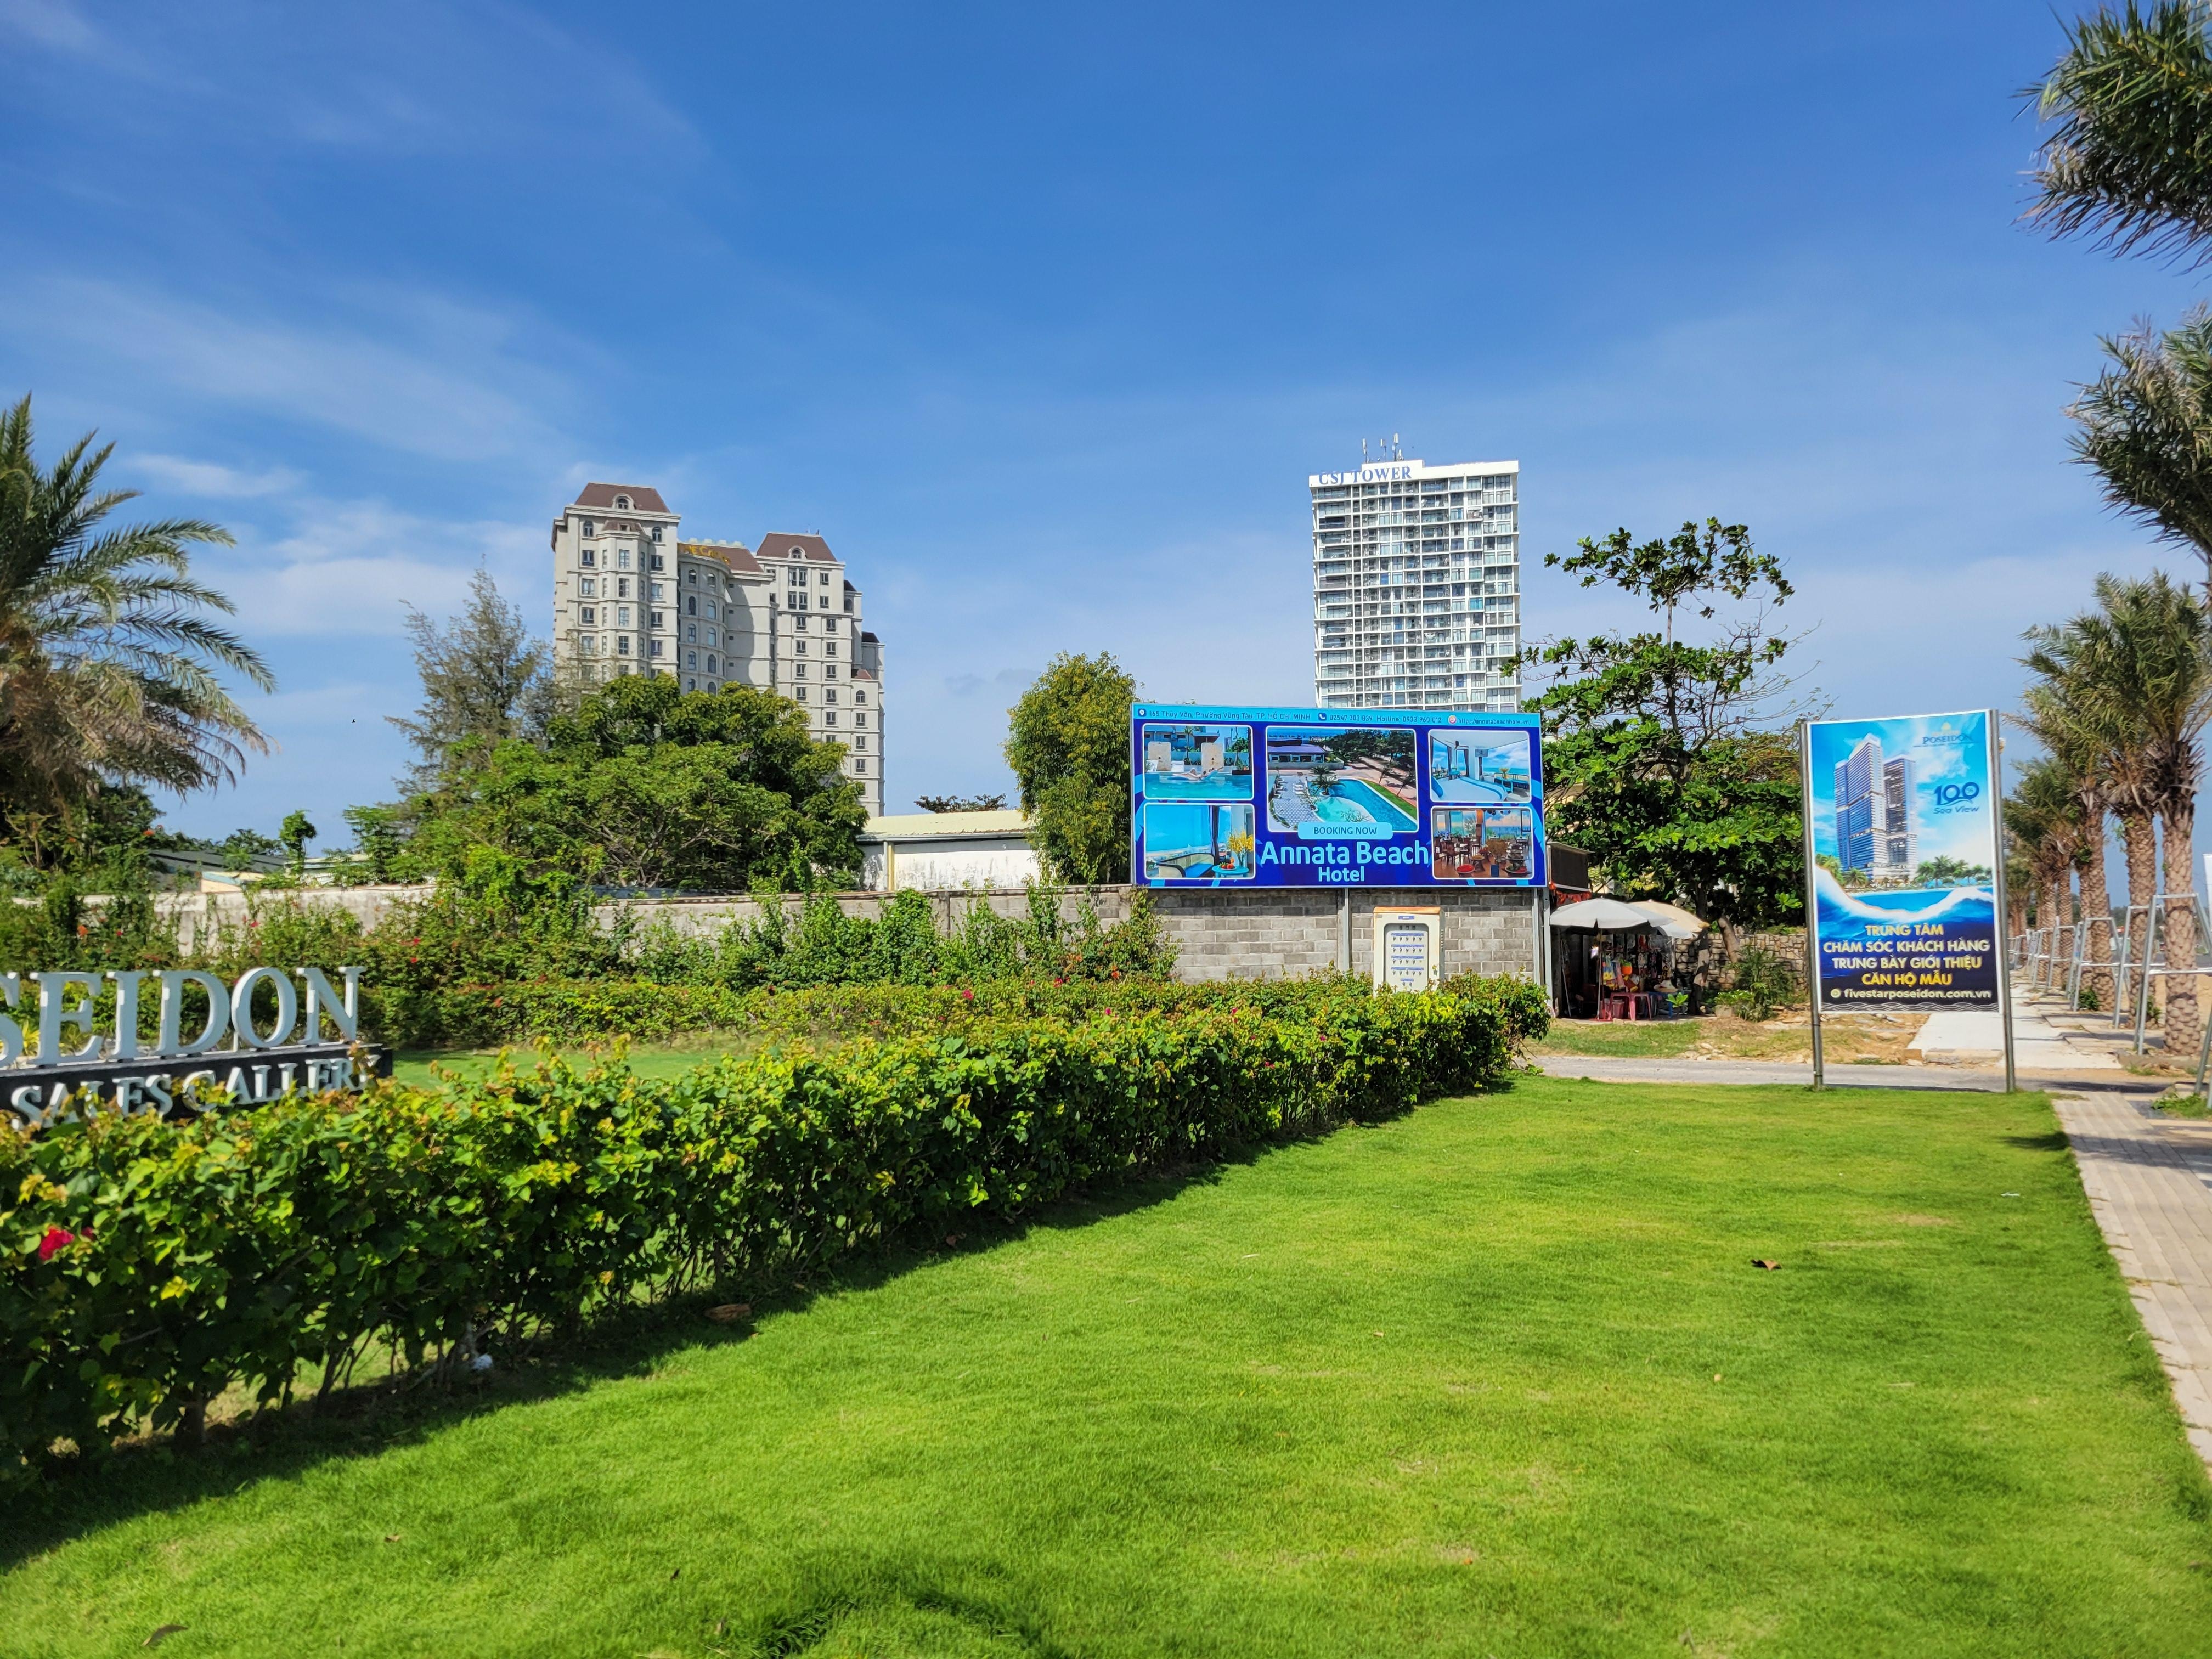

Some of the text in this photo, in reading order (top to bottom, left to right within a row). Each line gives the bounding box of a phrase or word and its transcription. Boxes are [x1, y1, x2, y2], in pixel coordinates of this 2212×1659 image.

[1319, 466, 1412, 485] CSJ TOWER
[1261, 840, 1429, 864] Annata Beach
[1318, 866, 1364, 882] Hotel
[1865, 923, 1944, 936] TRUNG TÂM
[1823, 940, 1863, 952] CHĂM
[1897, 939, 1944, 952] KHÁCH
[1947, 938, 1990, 952] HÀNG
[1881, 955, 1907, 968] BÀY
[1943, 955, 1982, 970] THIỆU
[1861, 972, 1892, 985] CĂN
[1894, 972, 1917, 988] HỘ
[1844, 989, 1991, 999] fivestarposeidon.com.vn
